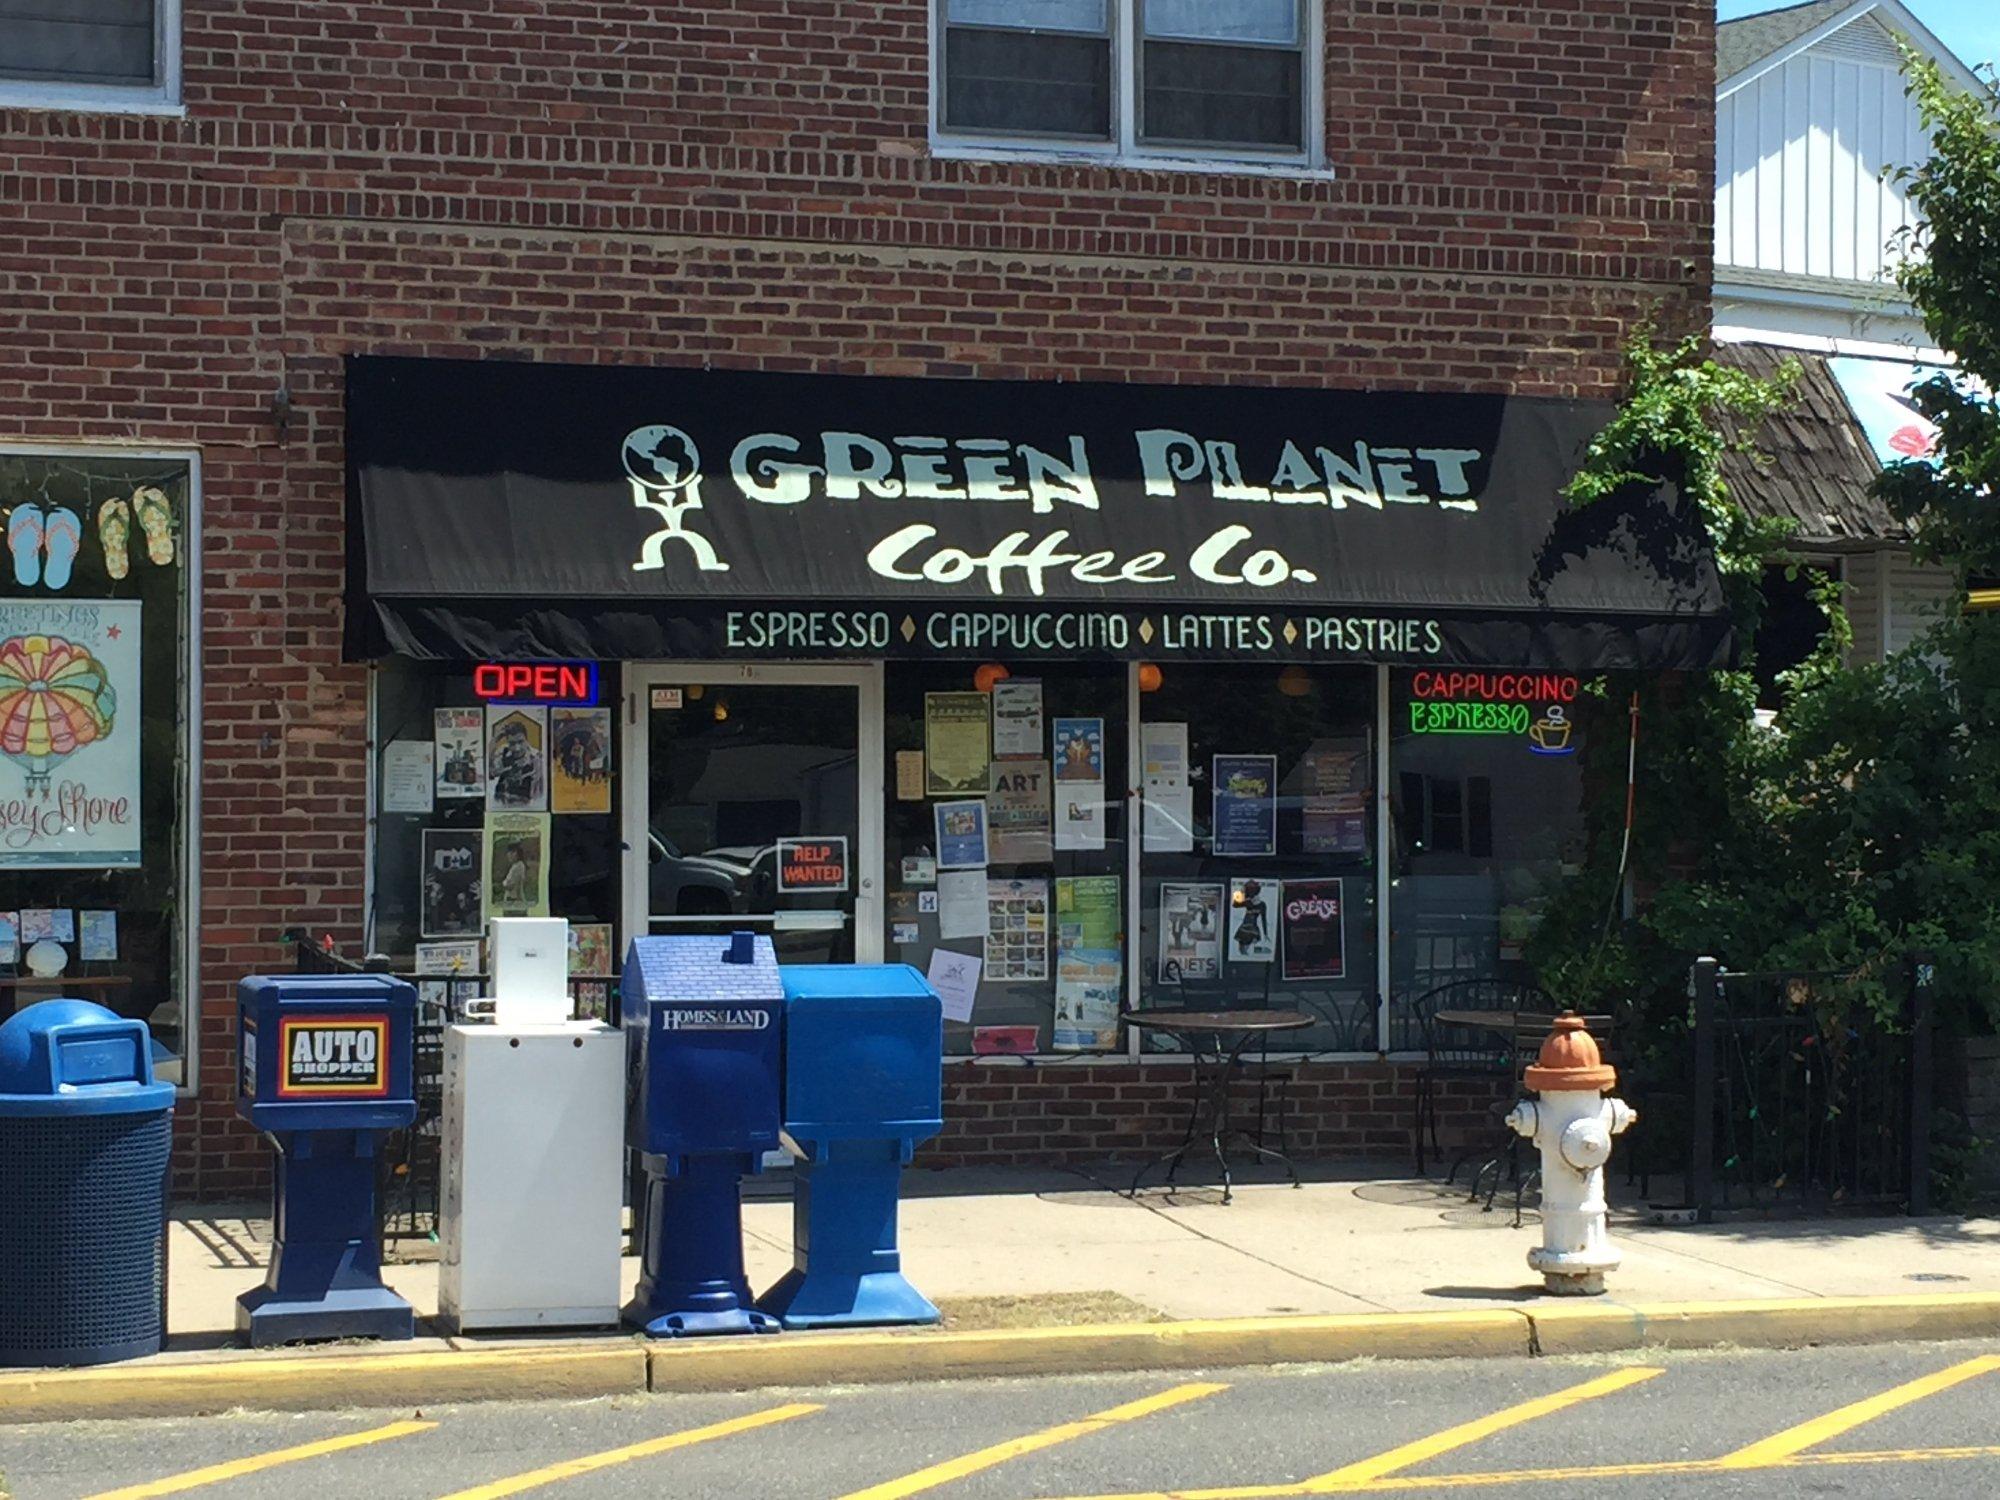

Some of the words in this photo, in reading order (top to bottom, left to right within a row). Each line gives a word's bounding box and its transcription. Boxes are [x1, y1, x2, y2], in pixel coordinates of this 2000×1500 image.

[729, 431, 1100, 514] GREEN
[1134, 428, 1482, 513] PLANET
[866, 523, 1176, 596] Coffee
[1189, 524, 1318, 587] Co.
[726, 611, 890, 649] ESPRESSO
[926, 612, 1130, 650] CAPPUCCINO
[1162, 614, 1274, 651] LATTES
[1305, 616, 1442, 654] PASTRIES
[473, 664, 588, 698] OPEN
[1412, 671, 1578, 702] CAPPUCCINO
[1411, 702, 1529, 735] ESPRESSO
[996, 774, 1041, 792] ART
[794, 846, 831, 861] HELP
[784, 866, 842, 882] WANTED
[1286, 896, 1338, 921] GREASE
[292, 1030, 376, 1063] AUTO
[292, 1063, 375, 1074] SHOPPER
